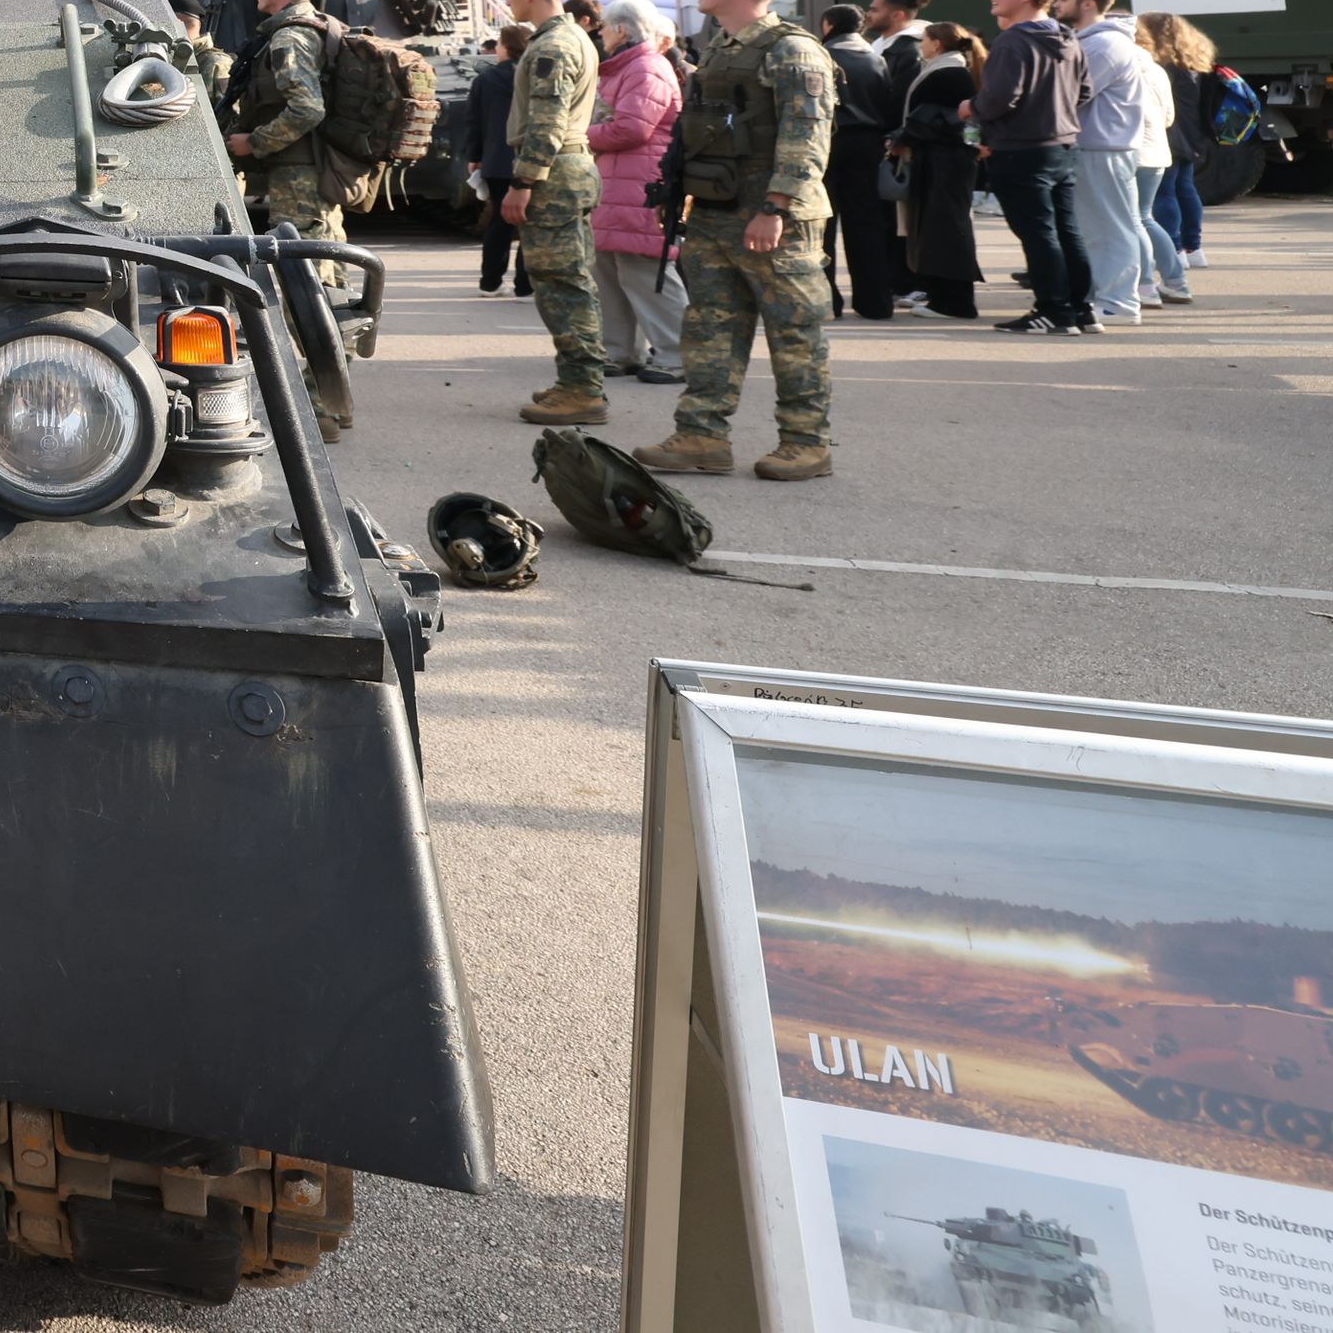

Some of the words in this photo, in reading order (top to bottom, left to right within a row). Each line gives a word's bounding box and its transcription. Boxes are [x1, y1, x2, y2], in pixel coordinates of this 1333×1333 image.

[808, 1032, 954, 1094] ULAN
[1198, 1202, 1231, 1221] Der
[1206, 1235, 1238, 1254] Der
[1242, 1242, 1333, 1272] Schützen
[1212, 1258, 1333, 1295] Panzergrena
[1292, 1299, 1333, 1316] sein
